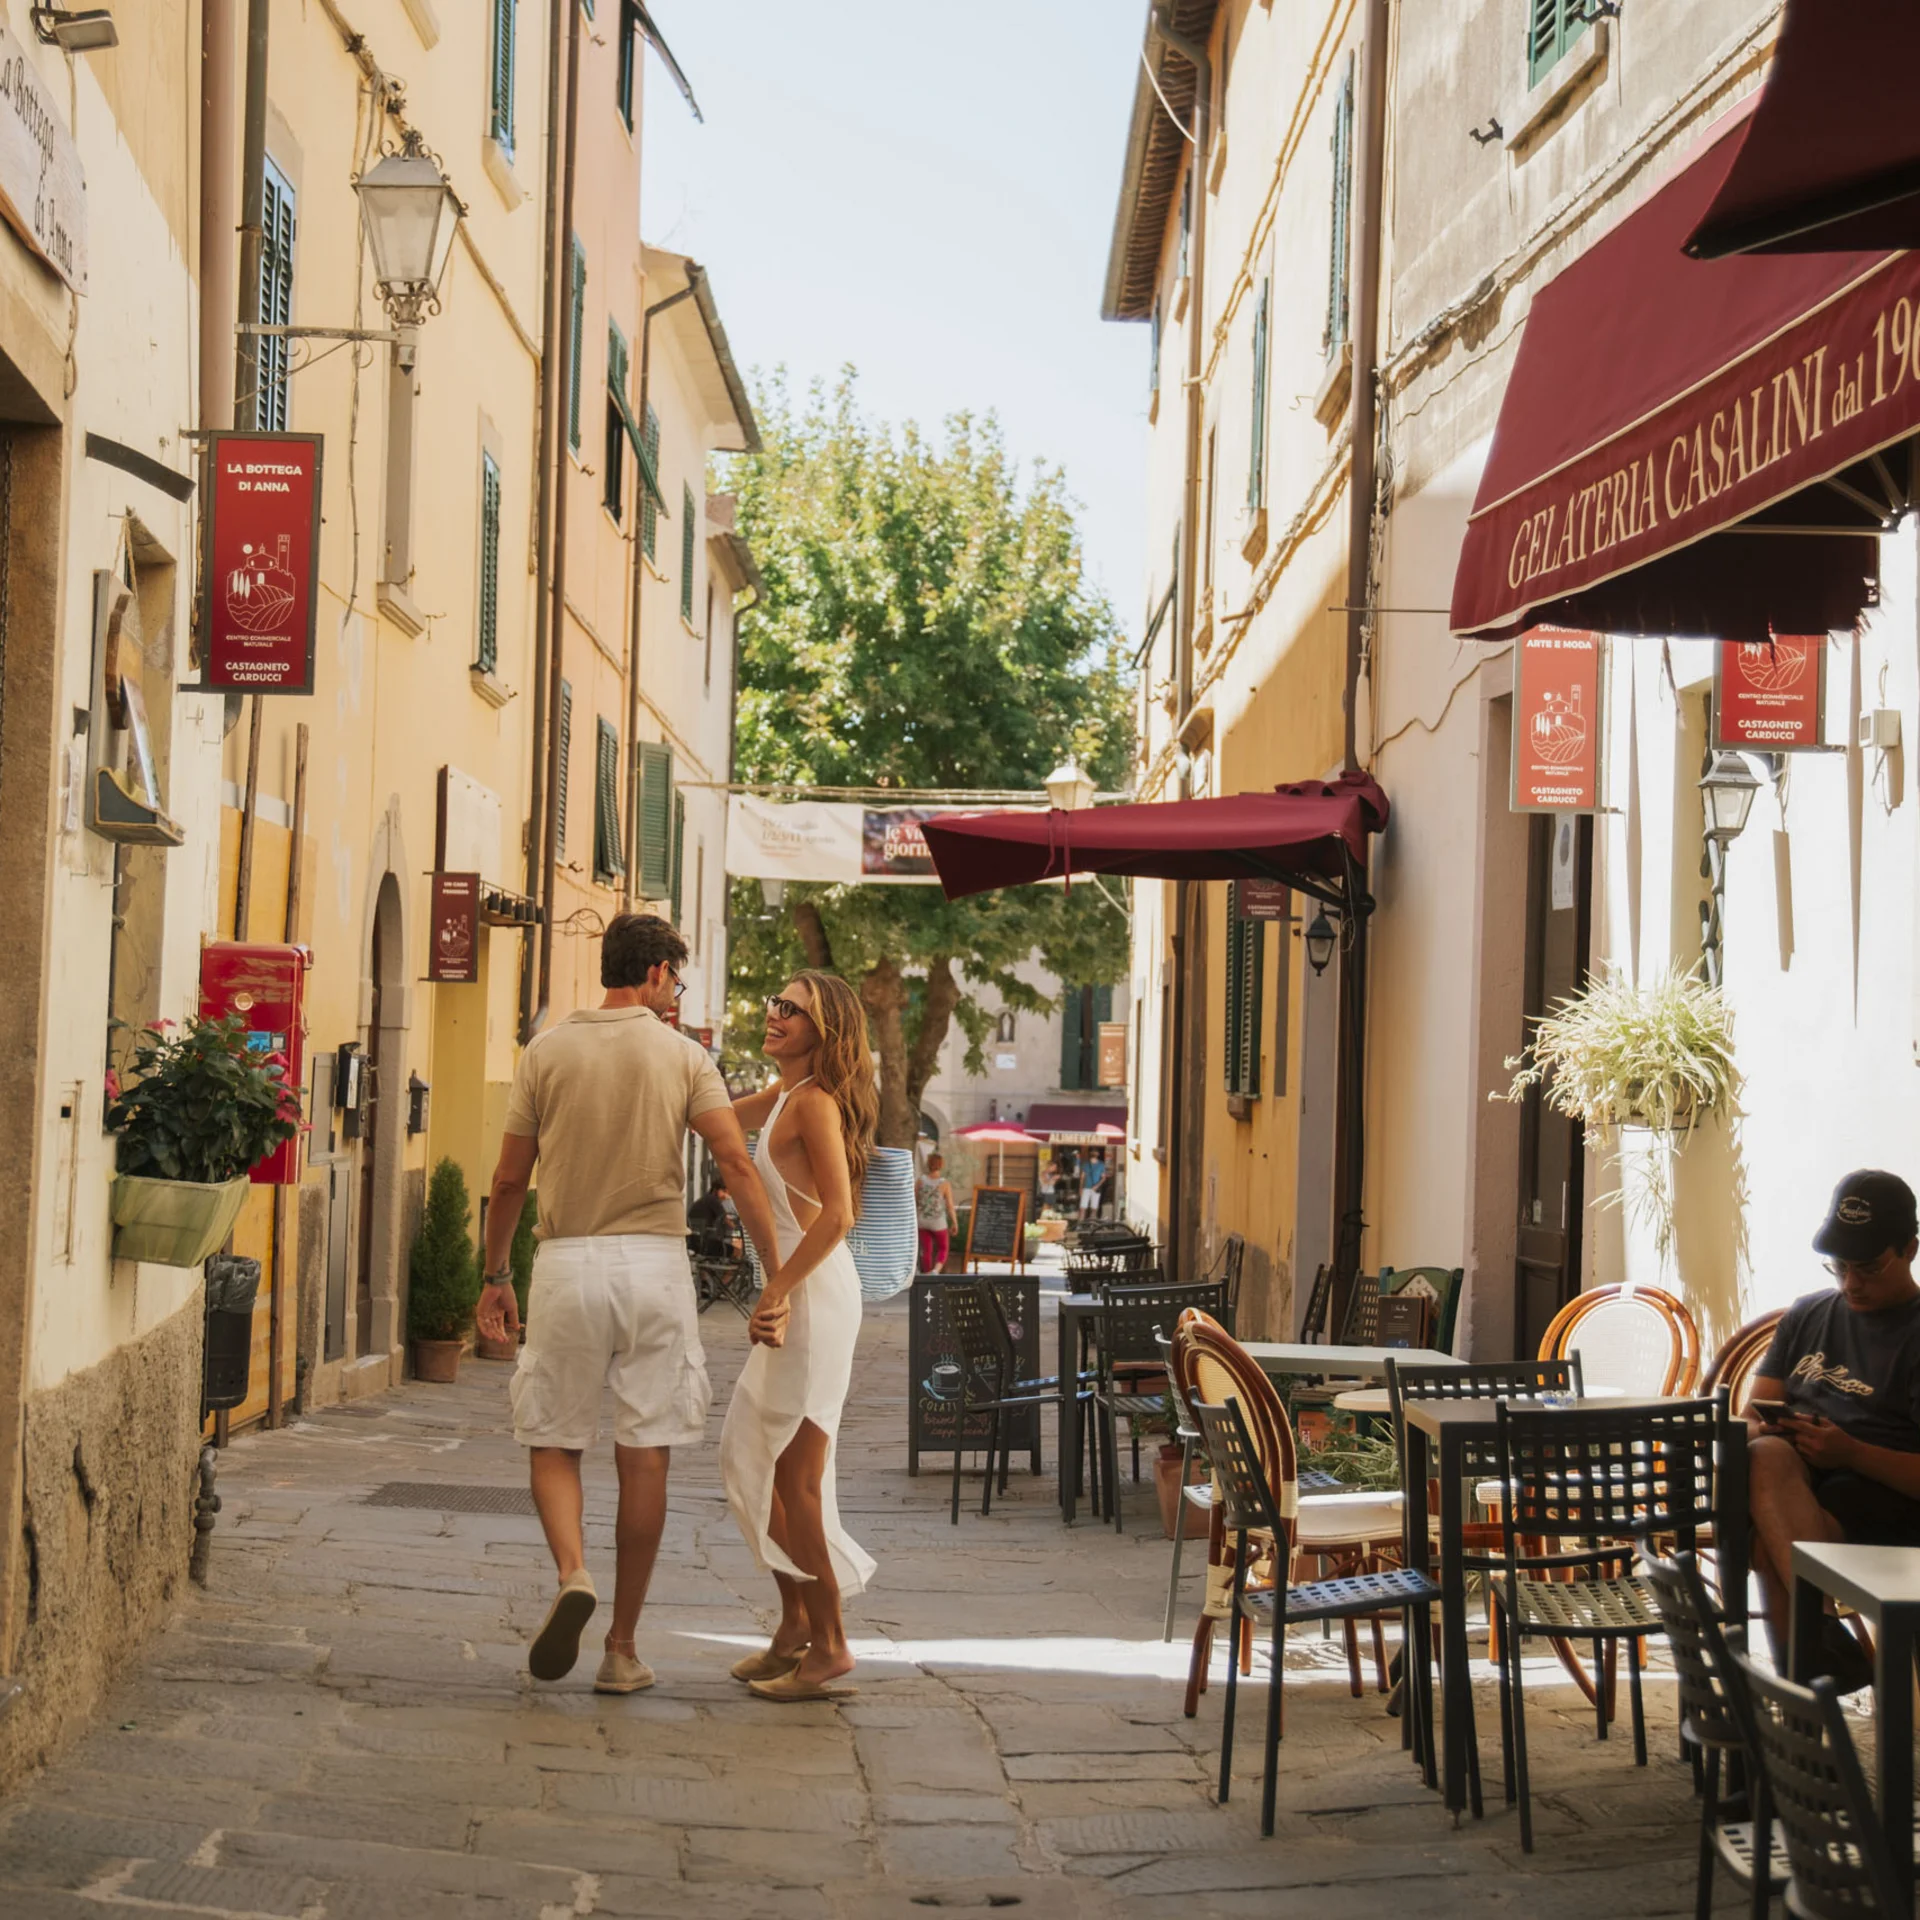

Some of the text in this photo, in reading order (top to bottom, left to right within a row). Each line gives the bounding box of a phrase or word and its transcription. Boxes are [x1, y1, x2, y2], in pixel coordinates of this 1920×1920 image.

[14, 55, 54, 176] Bottega
[34, 173, 45, 241] di
[227, 463, 302, 476] LA BOTTEGA
[1507, 456, 1659, 590] GELATERIA
[1664, 345, 1828, 520] CASALINI
[1831, 351, 1864, 428] dal
[238, 481, 290, 493] DI ANNA
[1526, 639, 1593, 649] ARTE E MODA
[225, 661, 290, 671] CASTAGNETO
[232, 672, 282, 682] CARDUCCI
[1738, 719, 1803, 730] CASTAGNETO
[1745, 730, 1795, 740] CARDUCCI
[1530, 786, 1584, 795] CASTAGNETO
[1536, 795, 1577, 804] CARDUCCI
[883, 842, 932, 861] giorn
